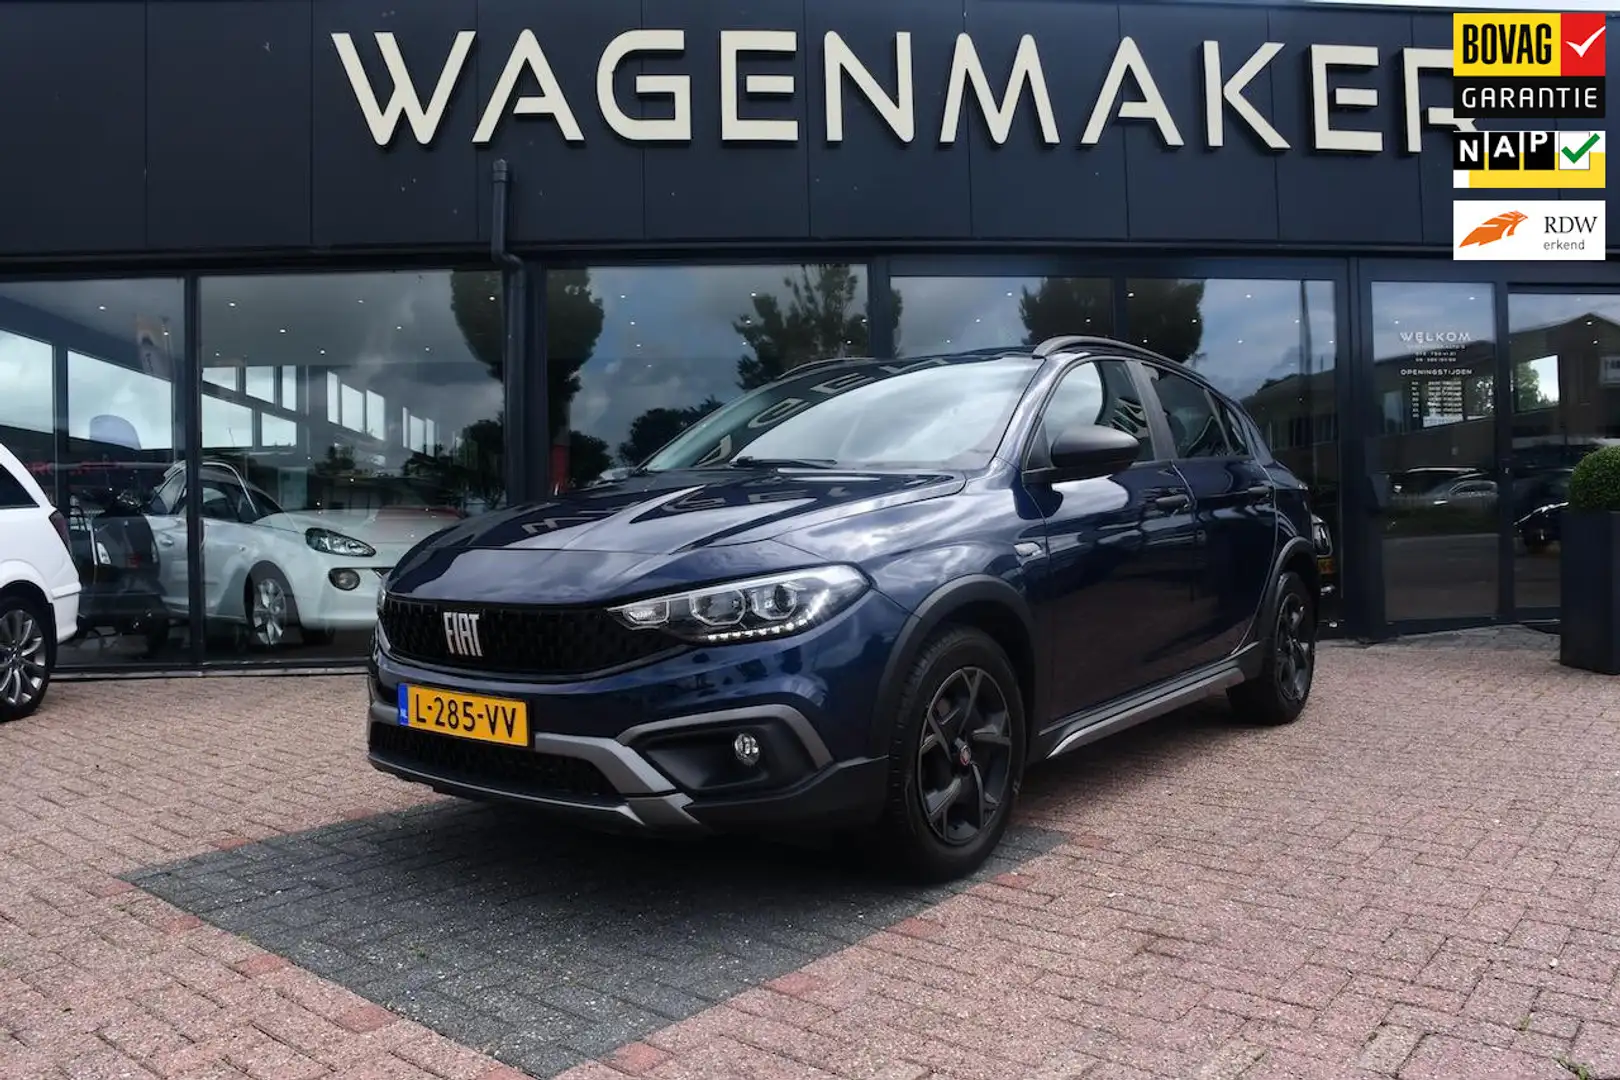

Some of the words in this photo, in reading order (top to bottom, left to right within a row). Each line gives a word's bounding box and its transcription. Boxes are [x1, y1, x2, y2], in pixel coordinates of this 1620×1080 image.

[1400, 331, 1471, 342] WELKOM
[1400, 368, 1473, 376] OPENINGSTIJDEN
[443, 611, 483, 657] FIAT
[415, 694, 517, 739] L-285-VV
